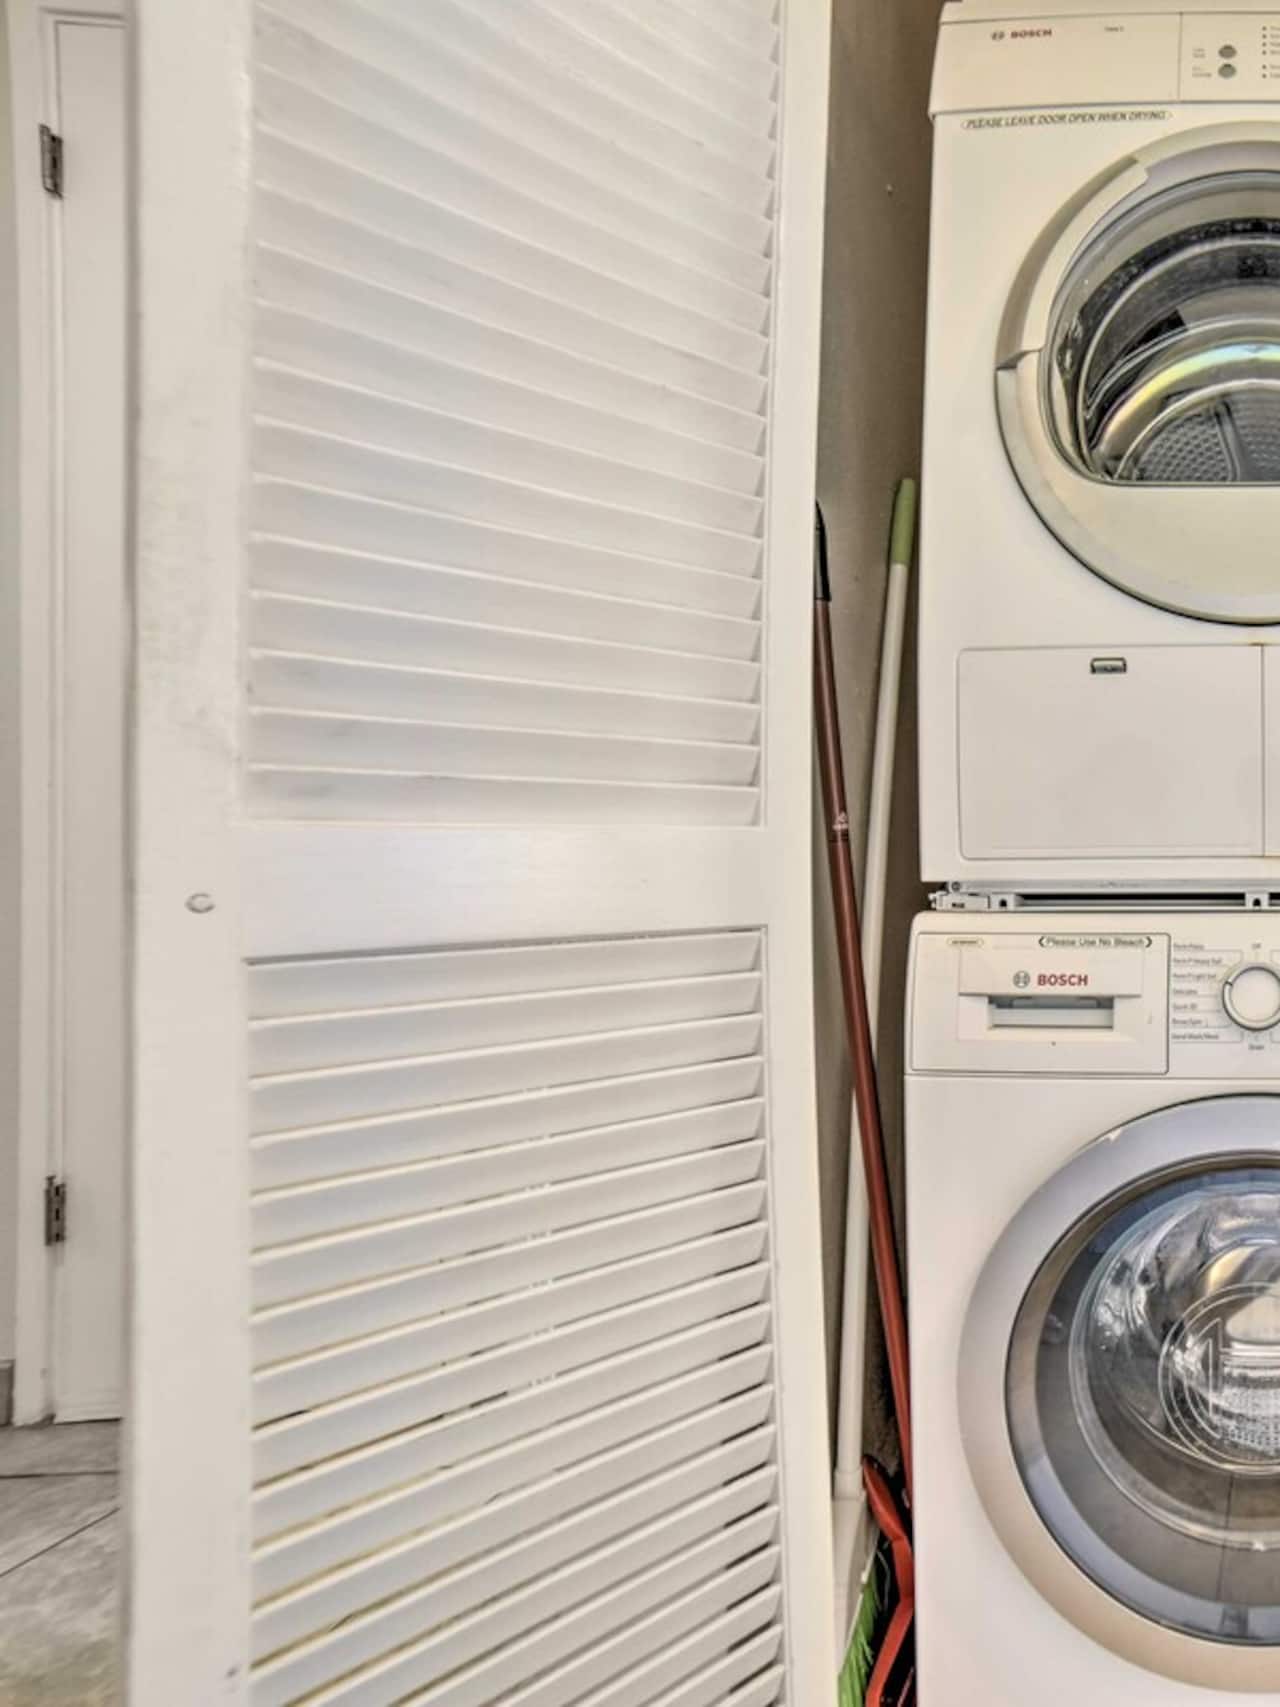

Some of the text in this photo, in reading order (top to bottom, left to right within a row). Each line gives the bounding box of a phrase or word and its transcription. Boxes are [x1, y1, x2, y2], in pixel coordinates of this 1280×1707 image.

[1010, 28, 1052, 39] BOSCH
[966, 110, 1166, 129] PLEASE LEAVE DOOR OPEN WHEN DRYING
[1046, 937, 1144, 947] Please Use No Bleach
[1037, 974, 1088, 986] BOSCH
